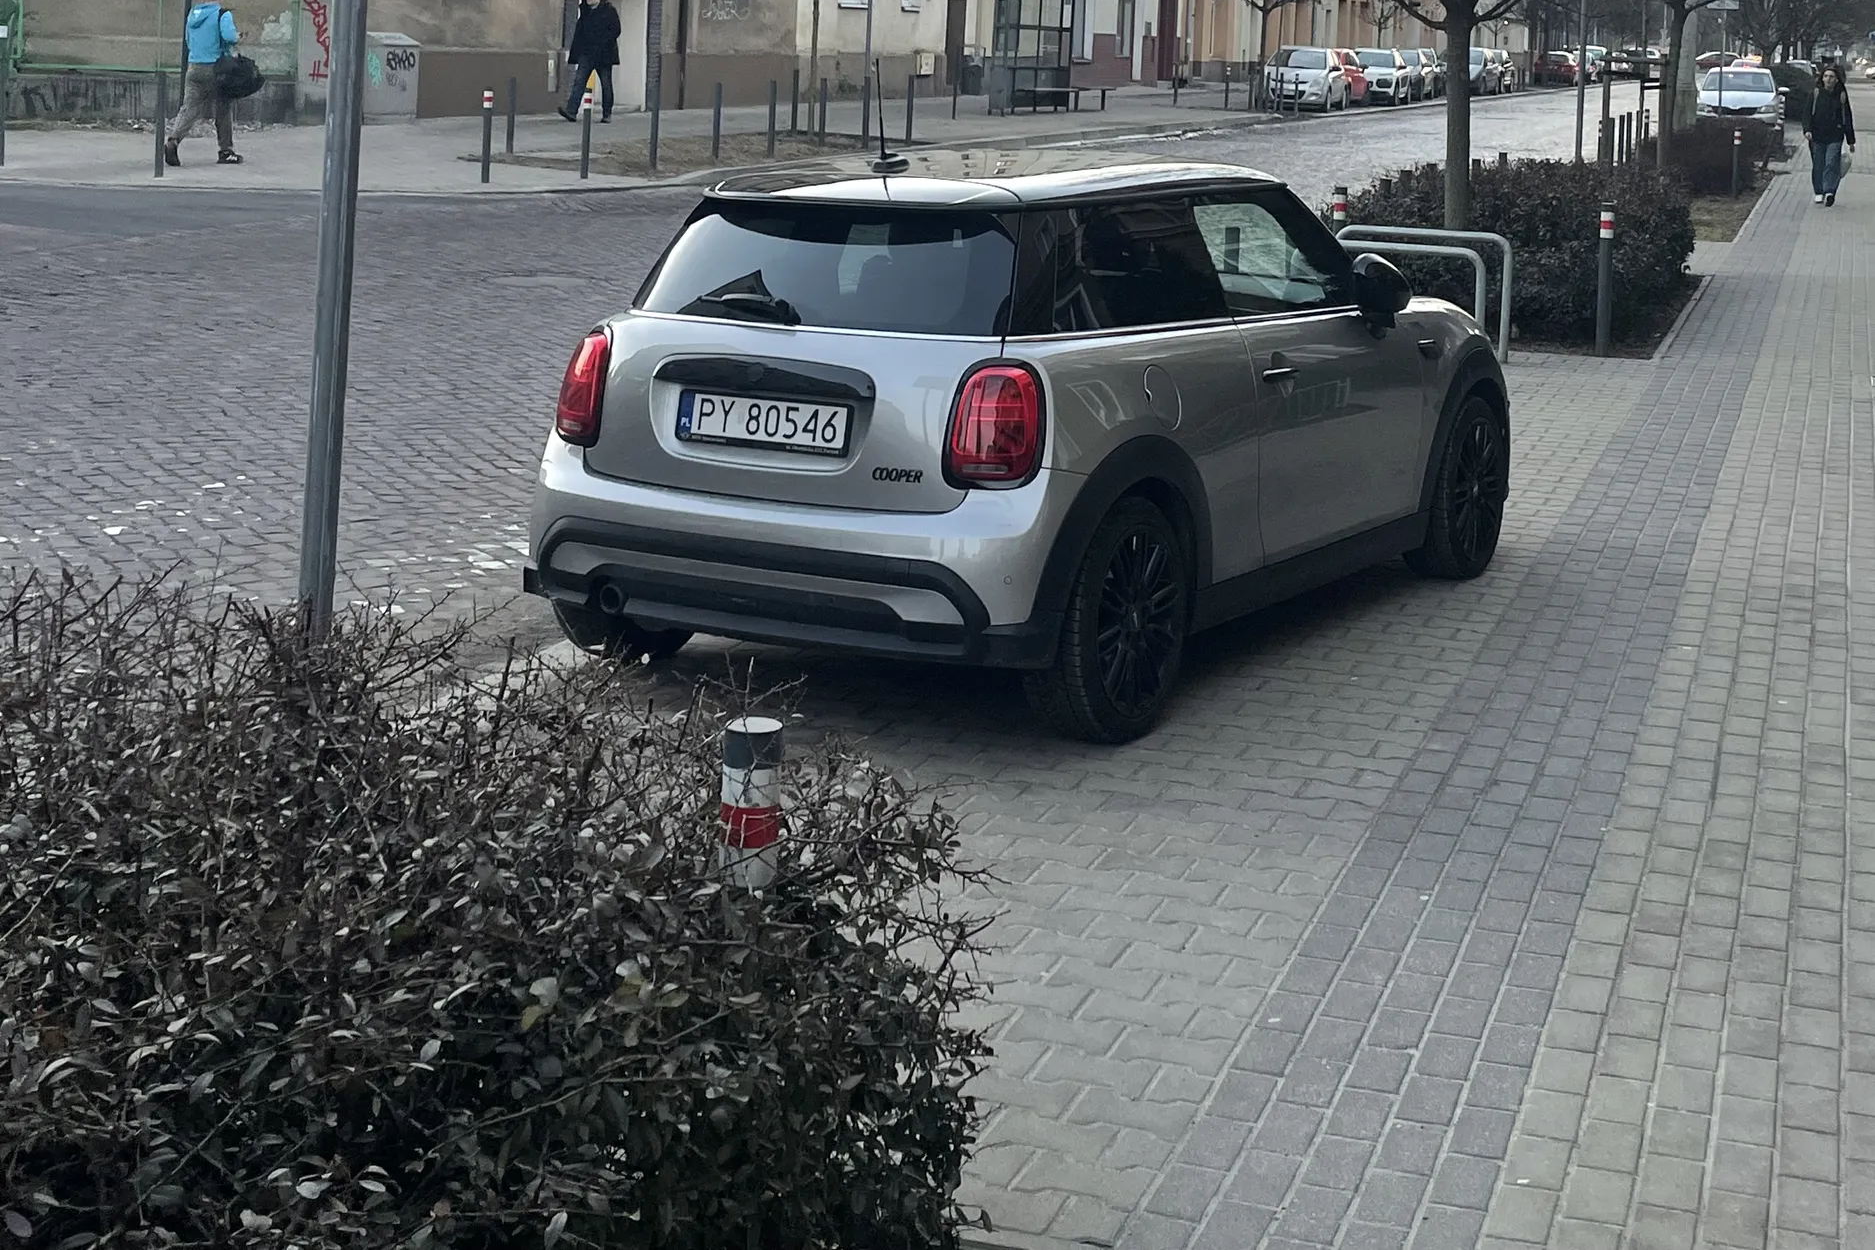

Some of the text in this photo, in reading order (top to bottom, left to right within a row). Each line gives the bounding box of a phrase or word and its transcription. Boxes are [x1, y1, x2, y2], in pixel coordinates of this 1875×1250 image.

[680, 416, 691, 428] PL
[697, 398, 839, 444] PY 80546
[872, 466, 924, 484] COOPER
